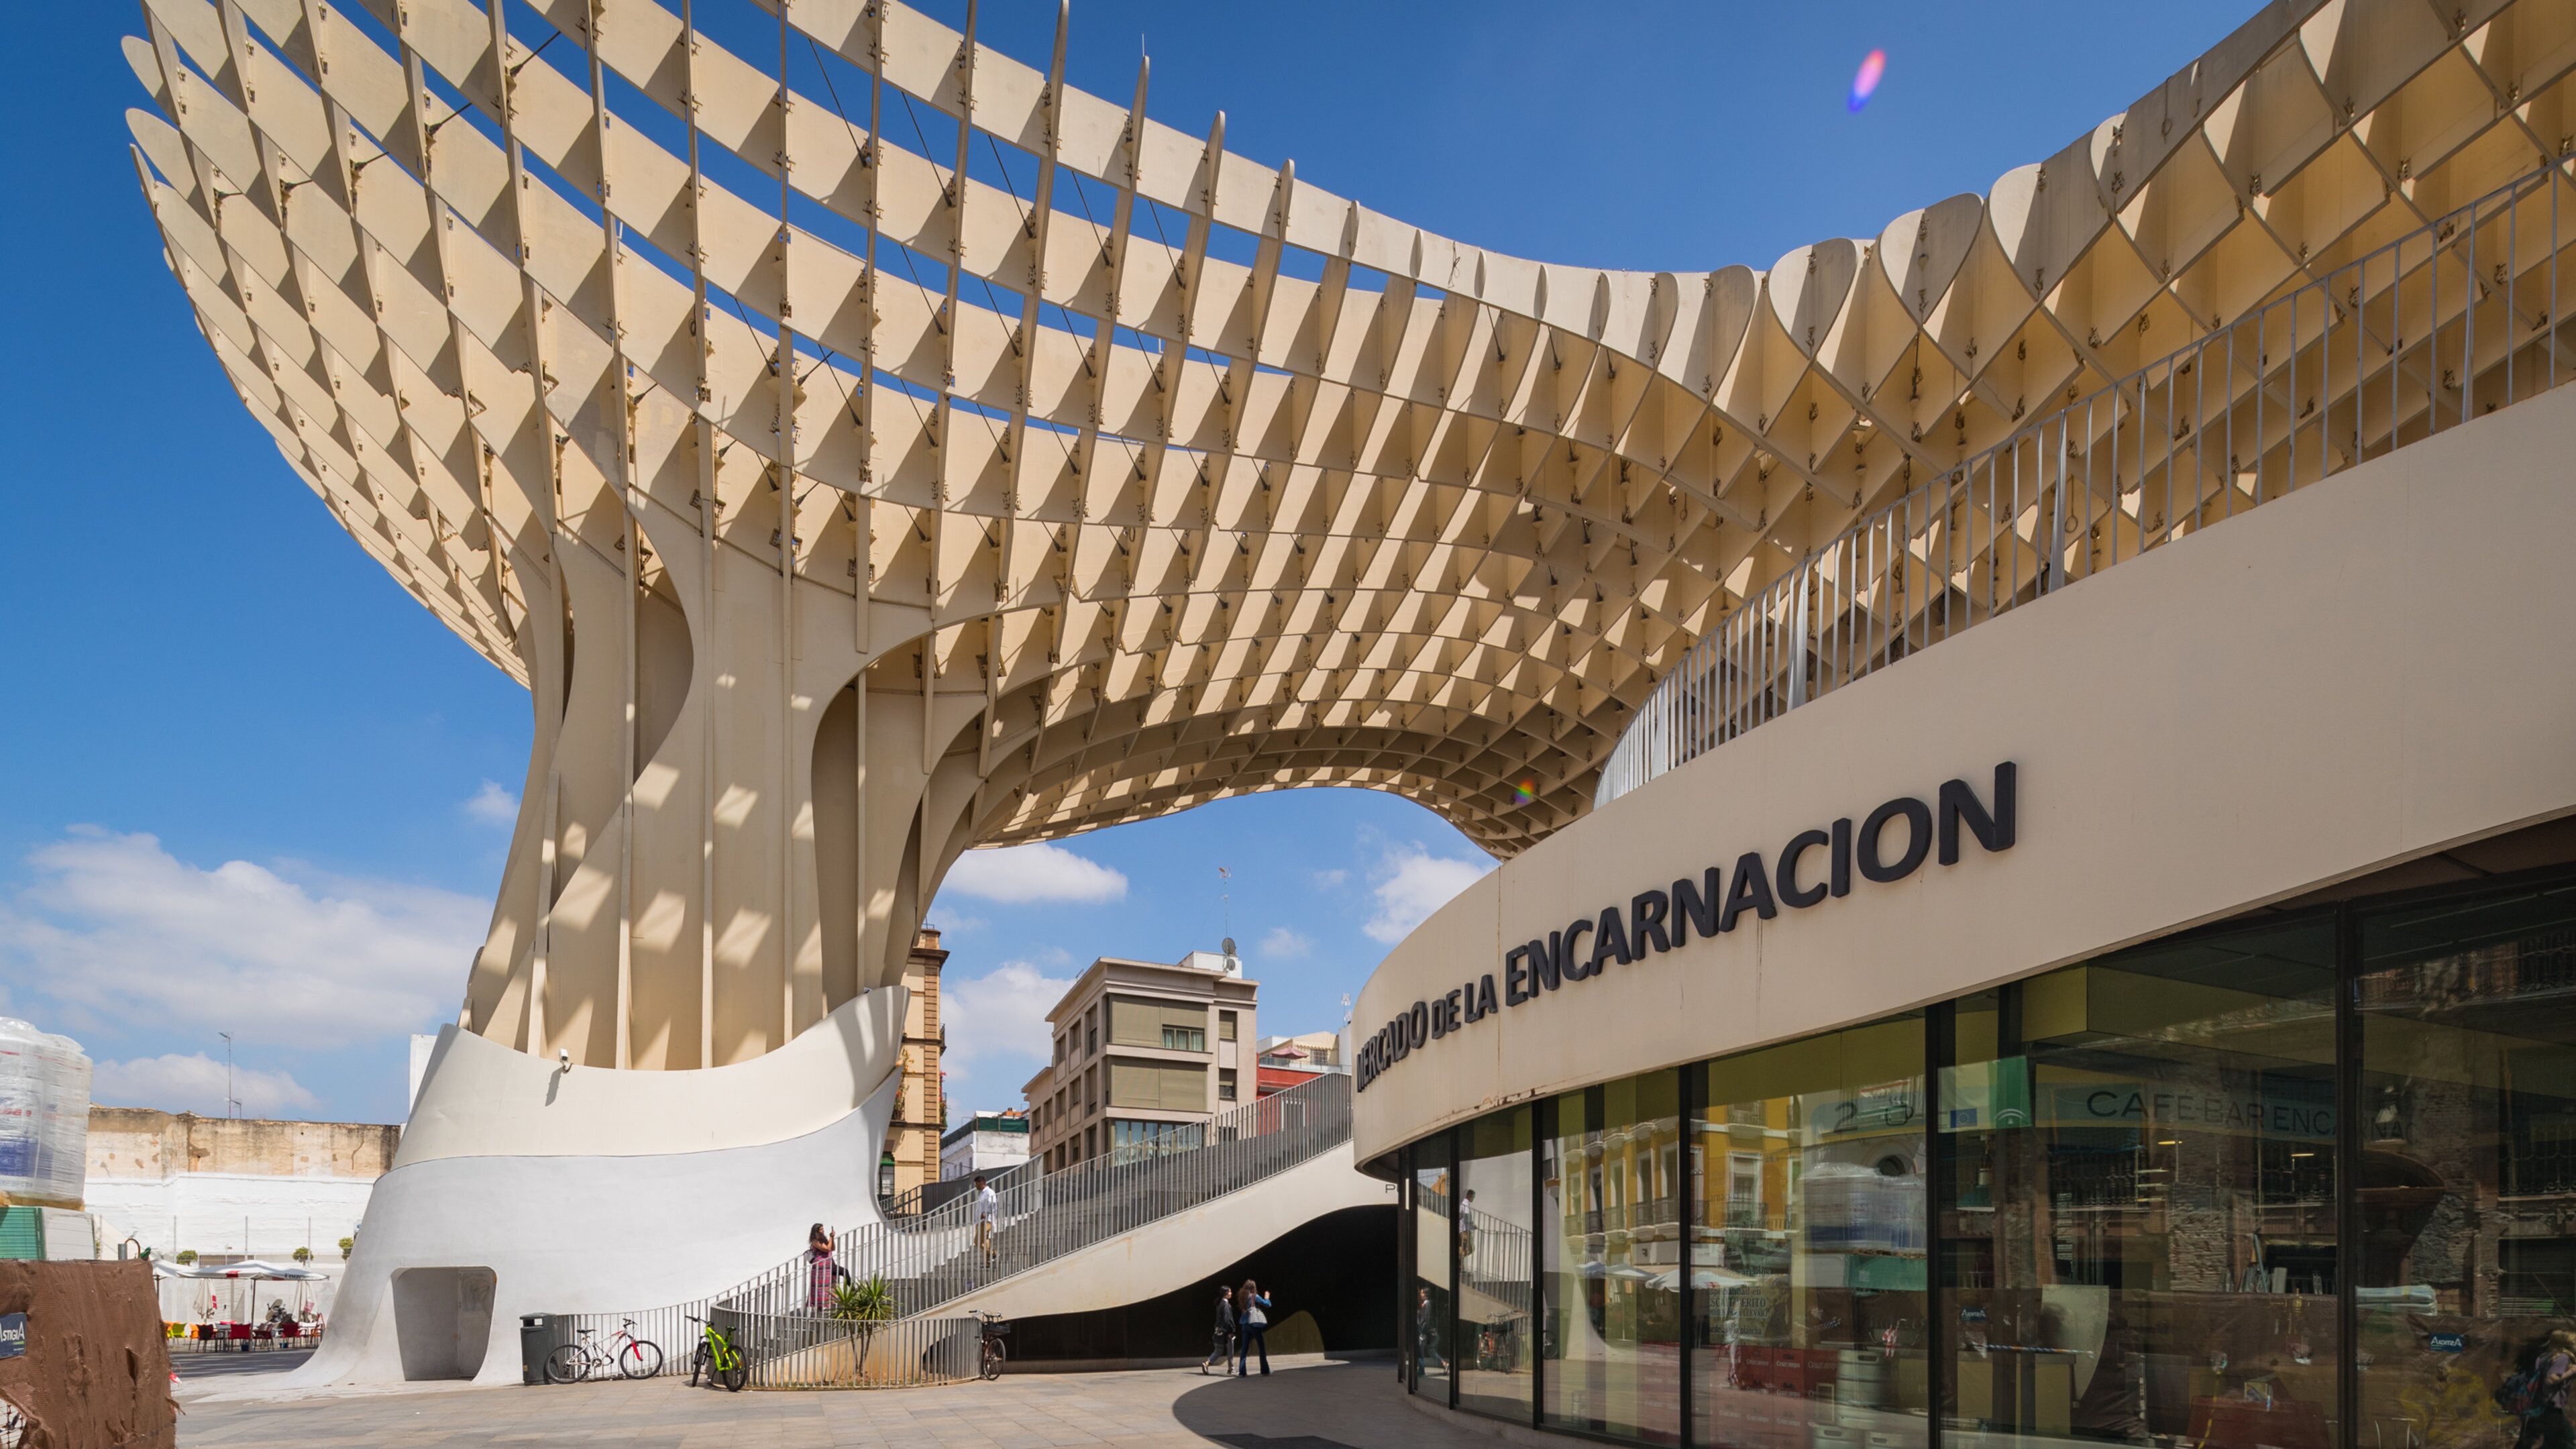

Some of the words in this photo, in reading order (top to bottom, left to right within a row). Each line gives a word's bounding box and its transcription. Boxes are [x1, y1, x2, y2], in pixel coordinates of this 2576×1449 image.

[1356, 1001, 1428, 1093] MERCADO
[1432, 989, 1461, 1040] DE
[1464, 974, 1498, 1024] LA
[1505, 761, 2017, 1006] ENCARNACION
[1808, 1360, 1836, 1371] Cruzcamp
